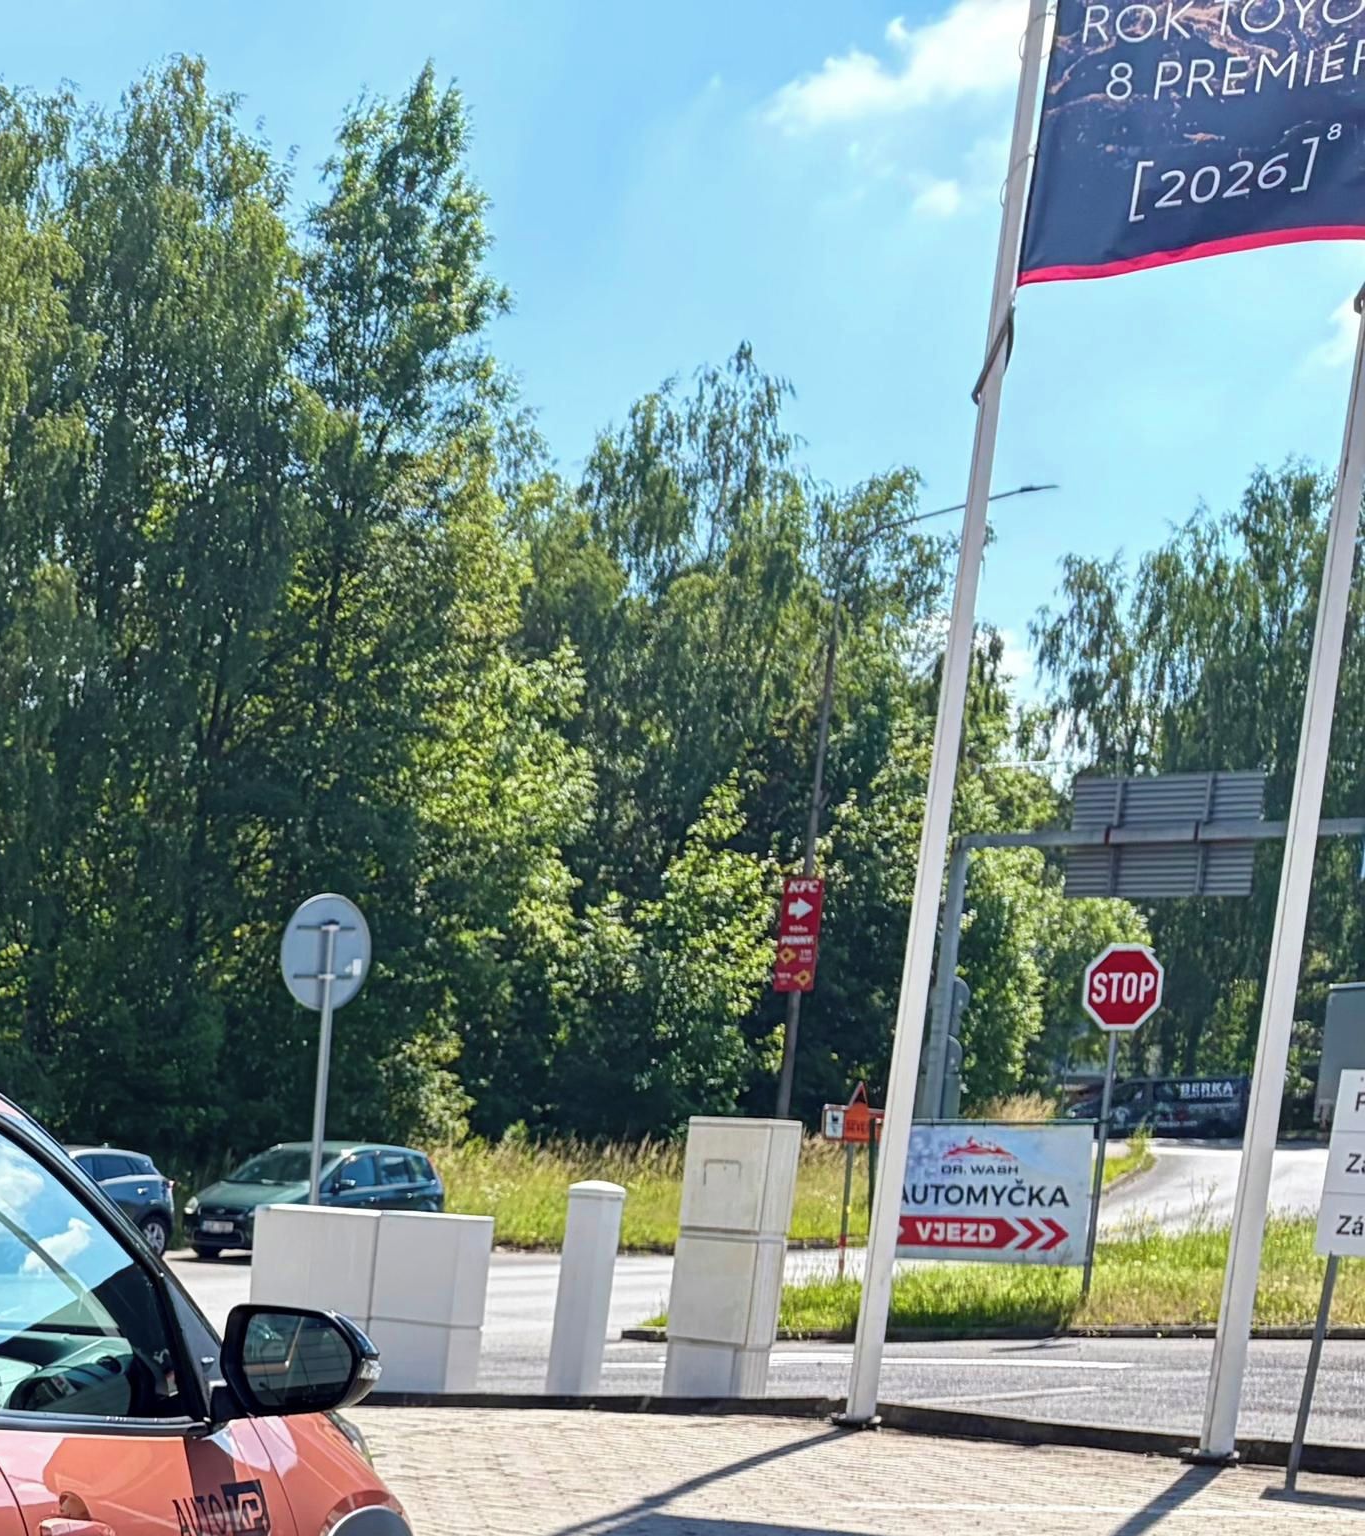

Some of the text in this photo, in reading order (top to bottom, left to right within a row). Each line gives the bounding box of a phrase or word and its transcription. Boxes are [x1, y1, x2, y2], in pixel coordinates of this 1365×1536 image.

[1082, 1, 1193, 43] ROK
[1106, 62, 1133, 101] 8
[1090, 969, 1157, 1005] STOP
[915, 1220, 997, 1243] VJEZD
